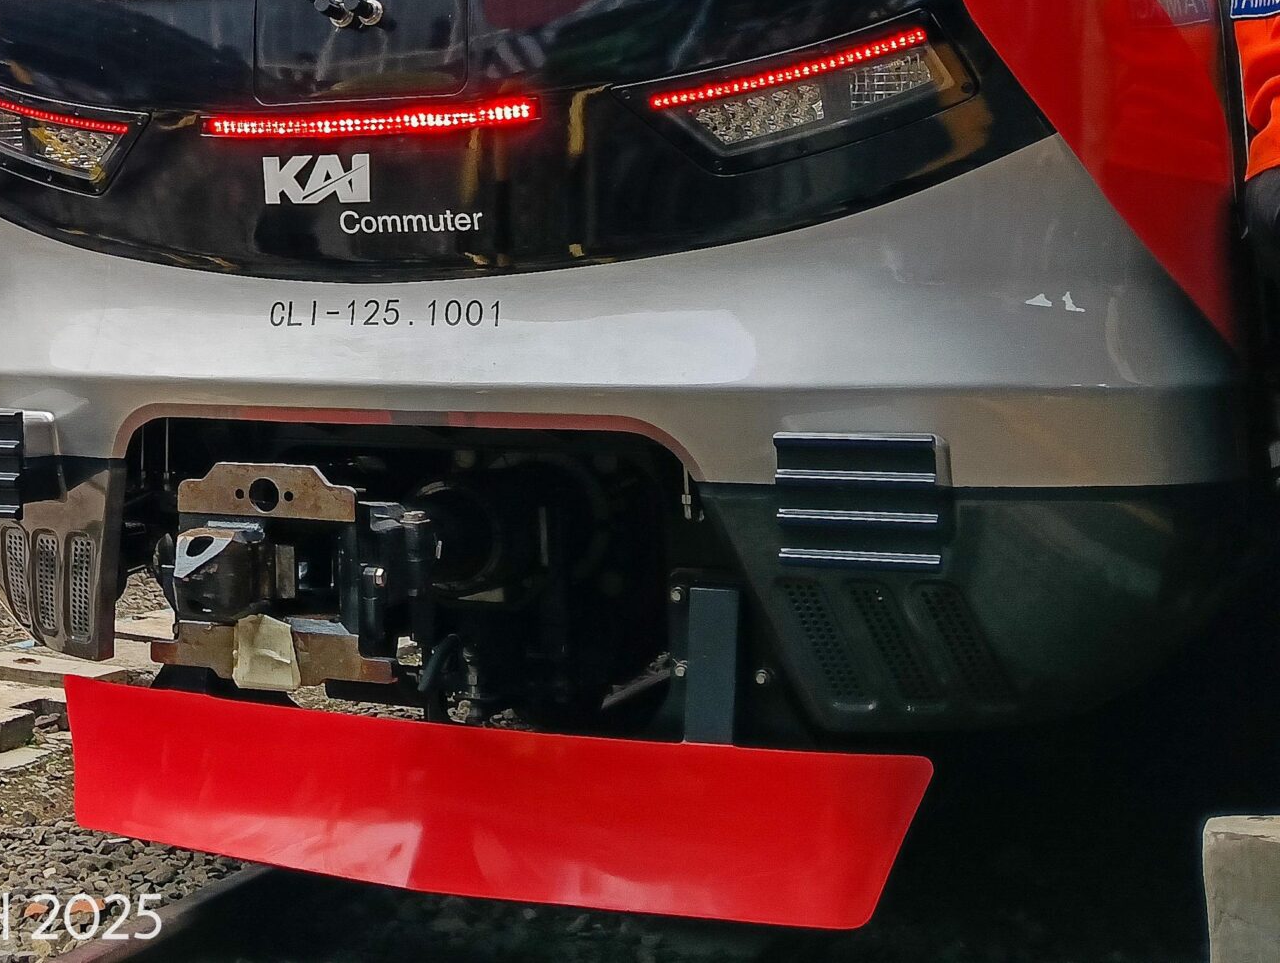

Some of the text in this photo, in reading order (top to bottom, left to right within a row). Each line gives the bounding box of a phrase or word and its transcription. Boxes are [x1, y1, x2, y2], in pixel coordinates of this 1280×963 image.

[262, 153, 371, 205] KAI
[339, 209, 484, 235] Commuter
[269, 299, 501, 328] CLI-125.1001
